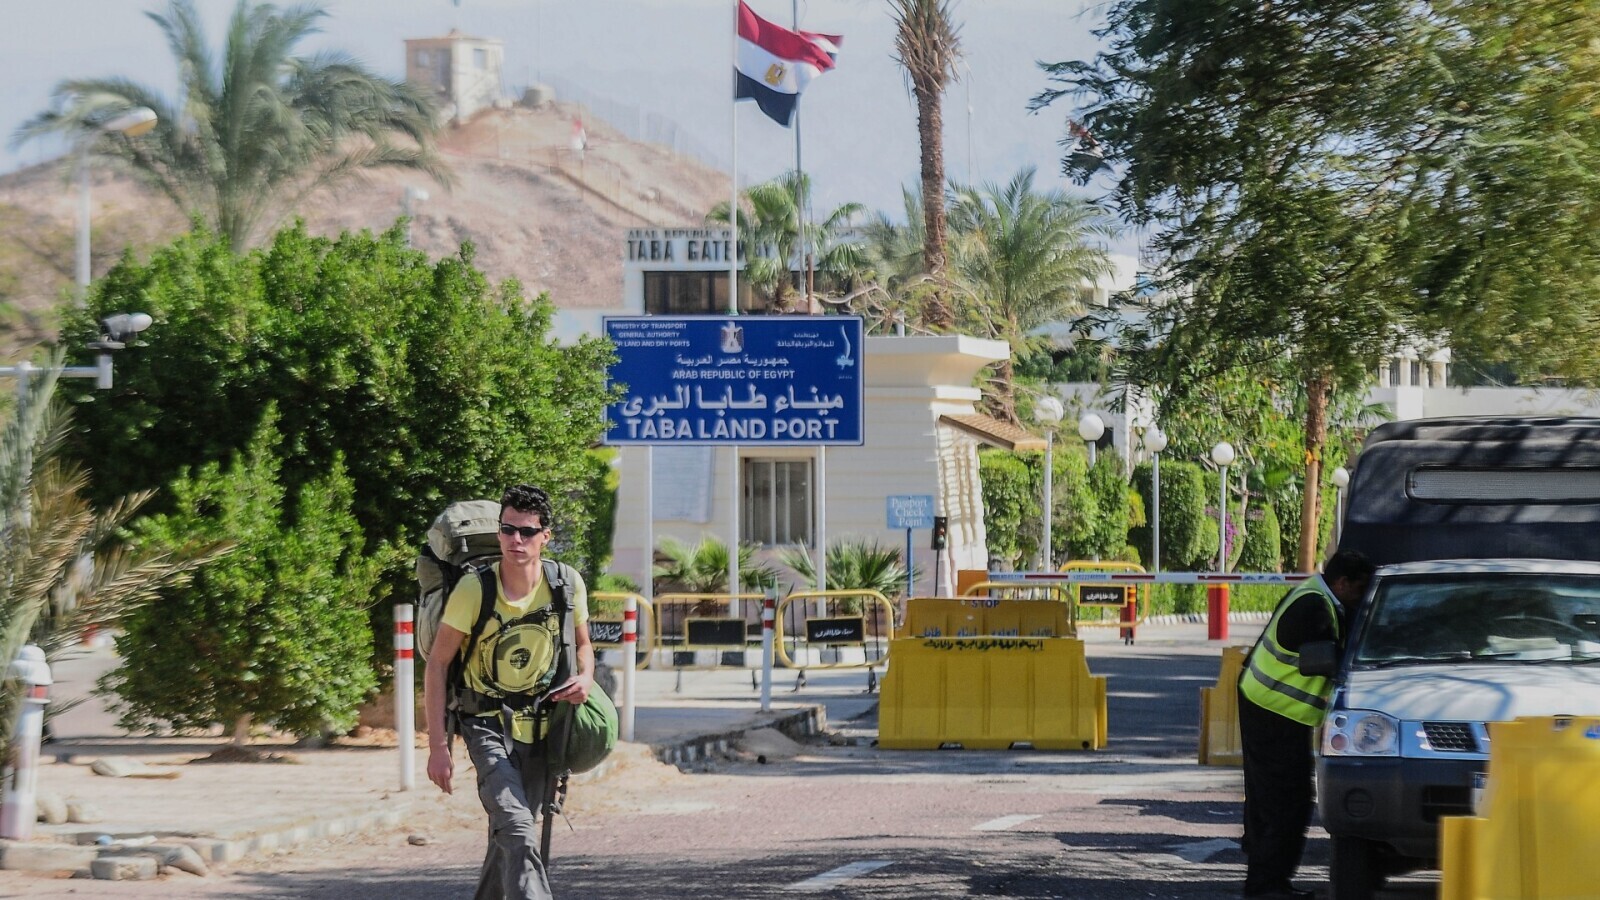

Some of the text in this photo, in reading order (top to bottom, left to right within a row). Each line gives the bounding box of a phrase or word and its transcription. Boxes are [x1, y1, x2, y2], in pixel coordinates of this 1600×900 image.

[664, 230, 714, 239] REPUBLIC
[627, 240, 674, 261] TABA
[624, 340, 641, 348] LAND
[641, 340, 655, 348] AND
[656, 340, 668, 348] DRY
[669, 340, 691, 348] PORTS
[676, 354, 790, 367] جمهورية مصر العربية
[672, 370, 796, 380] ARAB REPUBLIC OF EGYPT
[695, 383, 768, 417] طابا
[774, 384, 844, 416] ميناء
[626, 418, 840, 439] TABA LAND PORT
[891, 498, 928, 509] Passport
[895, 507, 926, 518] Check
[899, 517, 923, 528] Point
[971, 599, 1000, 609] STOP
